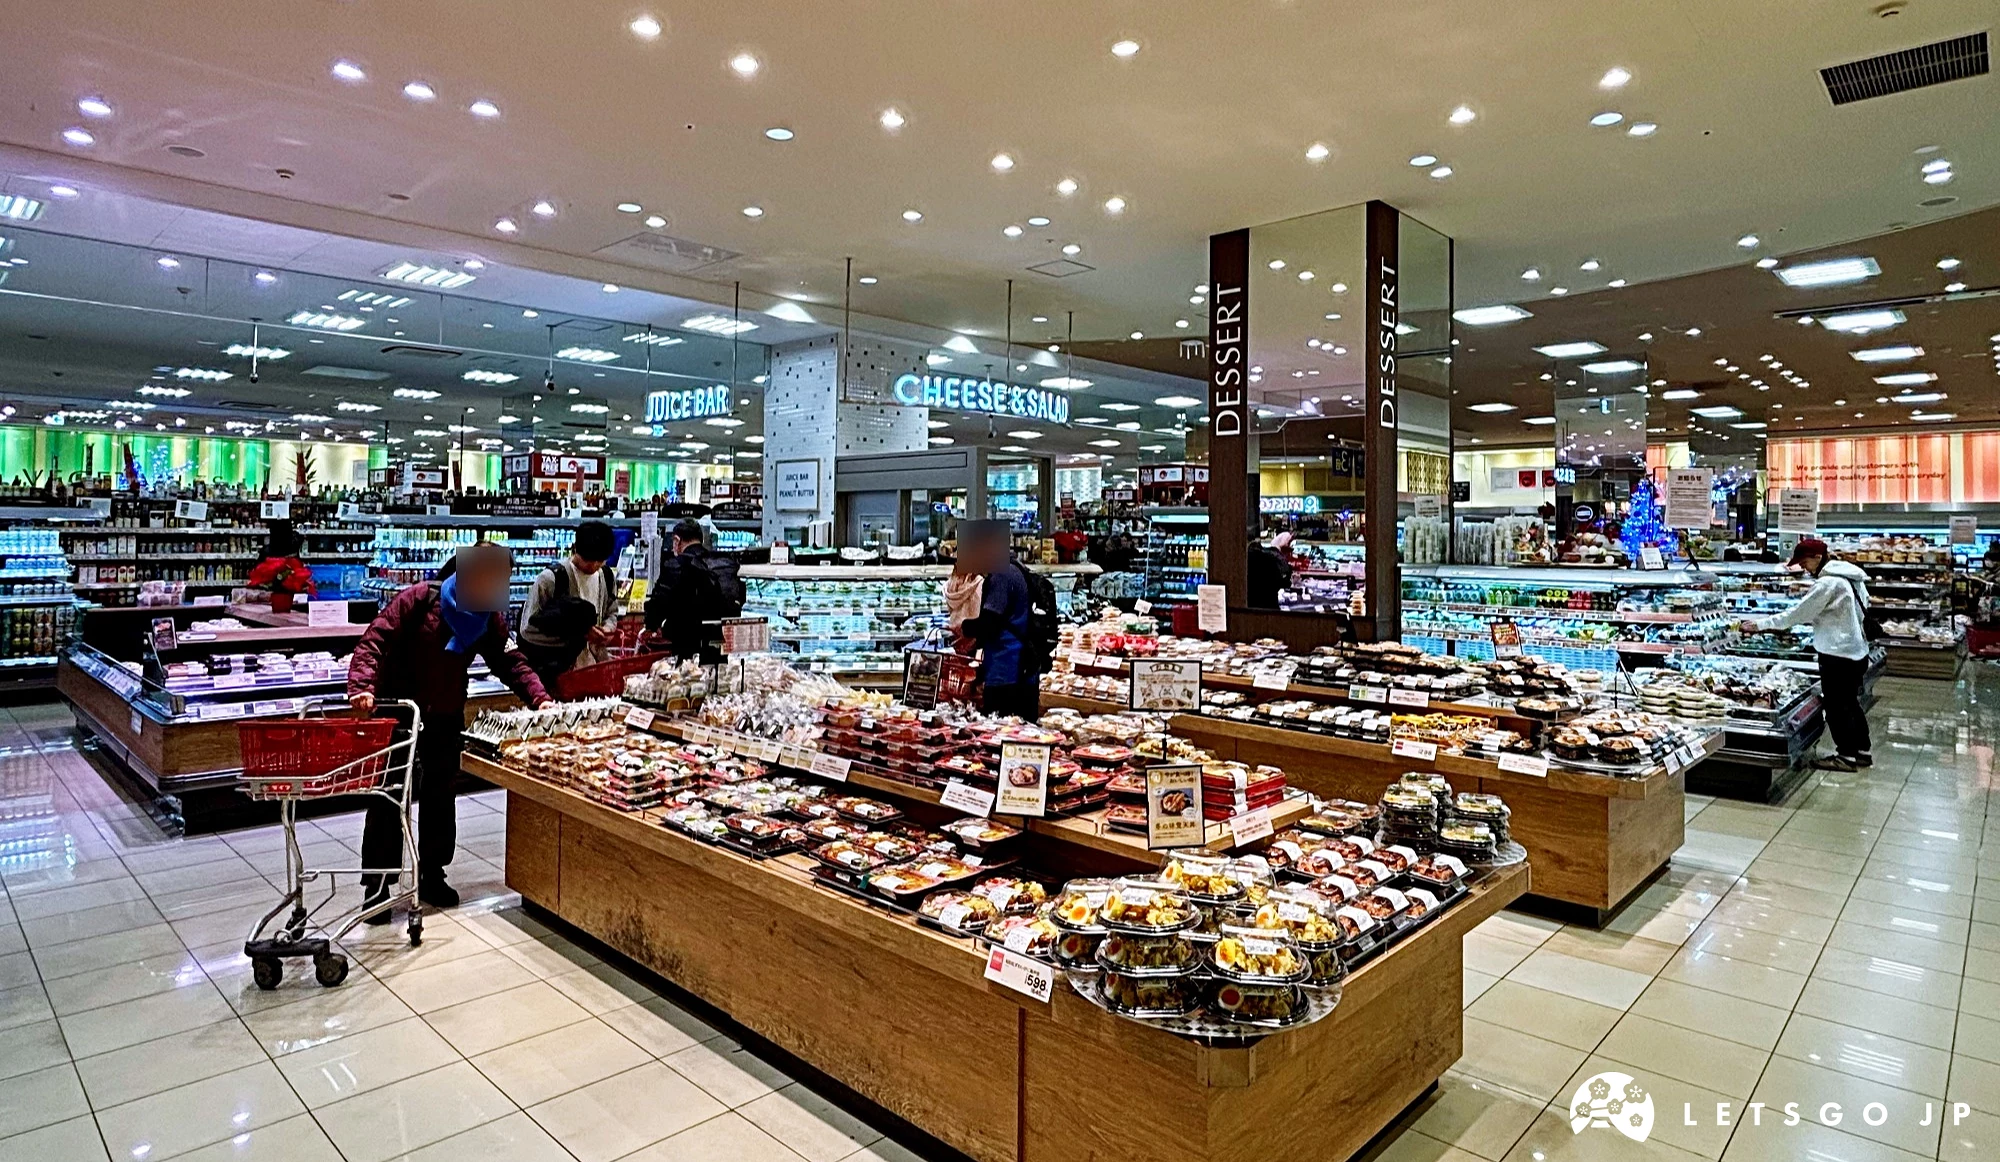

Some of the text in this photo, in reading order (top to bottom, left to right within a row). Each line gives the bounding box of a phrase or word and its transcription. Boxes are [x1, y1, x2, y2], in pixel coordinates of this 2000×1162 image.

[1215, 283, 1241, 436] DESSERT
[1378, 256, 1395, 428] DESSERT
[645, 384, 729, 423] JUICE BAR
[894, 373, 1069, 424] CHEESE & SALAD
[786, 473, 798, 481] JUICE
[1026, 974, 1047, 992] 598
